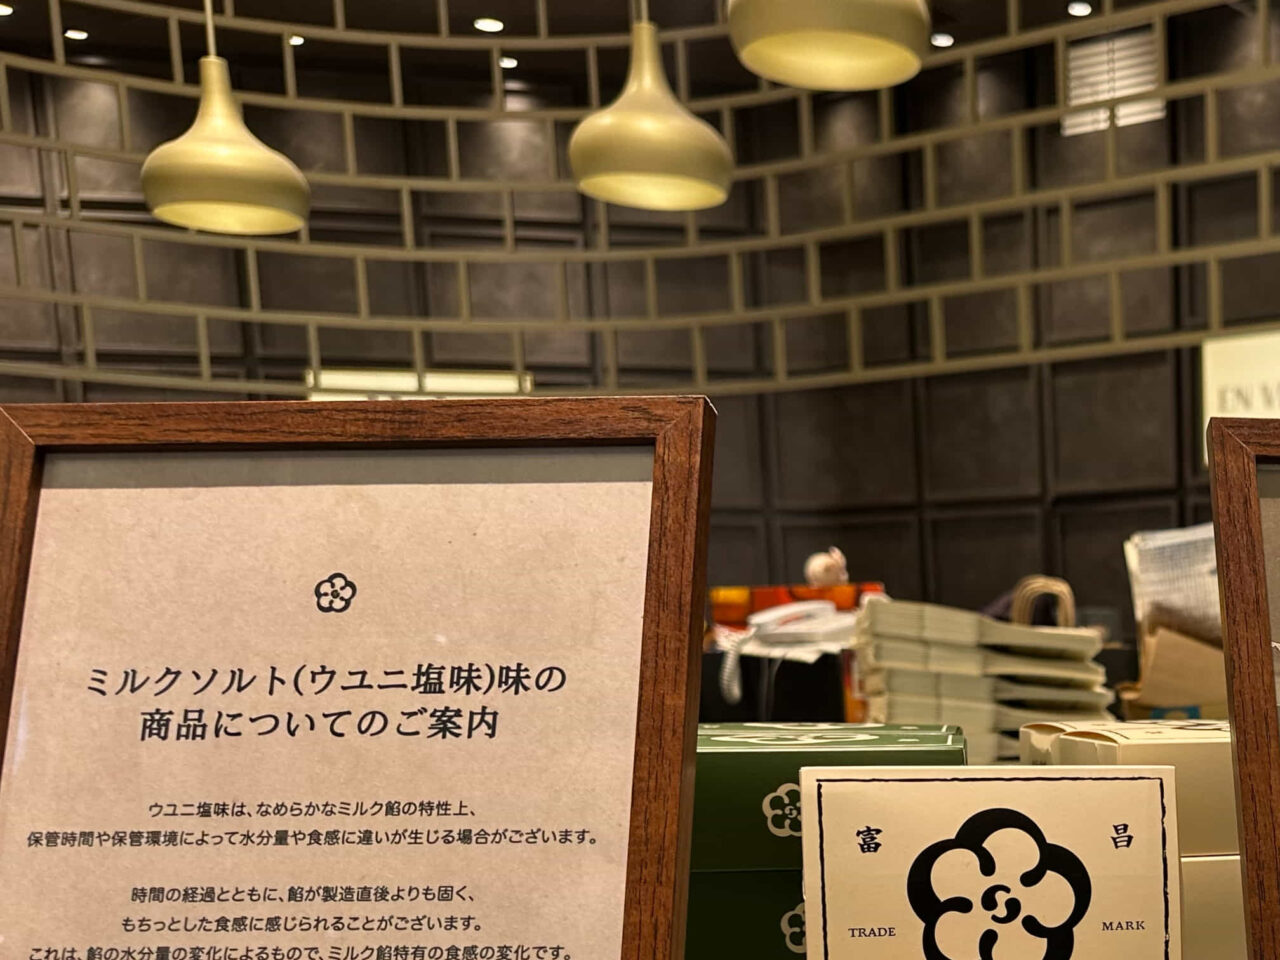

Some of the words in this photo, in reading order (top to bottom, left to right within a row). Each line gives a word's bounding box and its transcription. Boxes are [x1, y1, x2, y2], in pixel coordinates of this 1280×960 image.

[86, 663, 567, 697] ミルクソルト(ウユニ塩味)味の
[140, 707, 500, 742] 商品についてのご案内
[855, 825, 883, 854] 富
[1110, 823, 1135, 850] 昌
[121, 915, 482, 934] もちっとした食感に感じられることがございます。
[848, 926, 897, 939] TRADE
[1102, 920, 1146, 932] MARK
